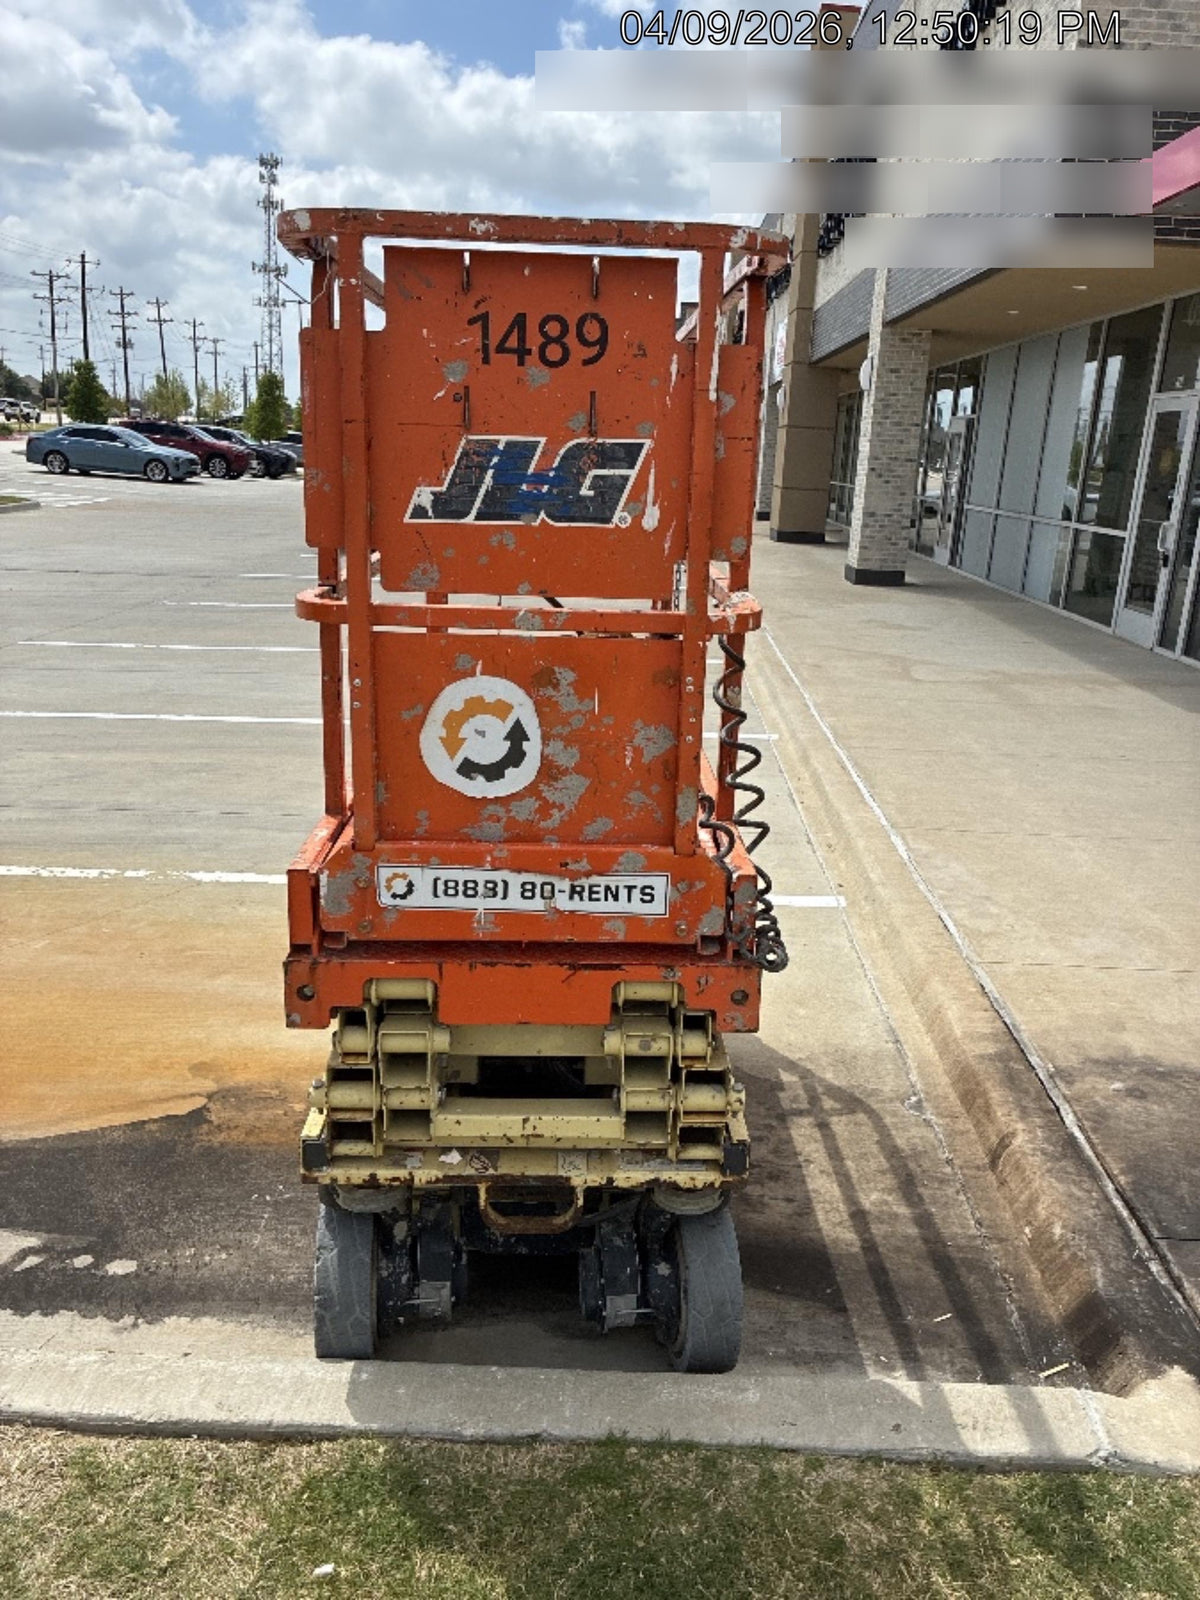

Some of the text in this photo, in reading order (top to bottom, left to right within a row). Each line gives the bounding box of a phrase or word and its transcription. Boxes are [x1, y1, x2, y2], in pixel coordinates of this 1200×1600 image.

[467, 311, 609, 368] 1489
[404, 435, 653, 527] JLG
[520, 880, 656, 904] 80-RENTS
